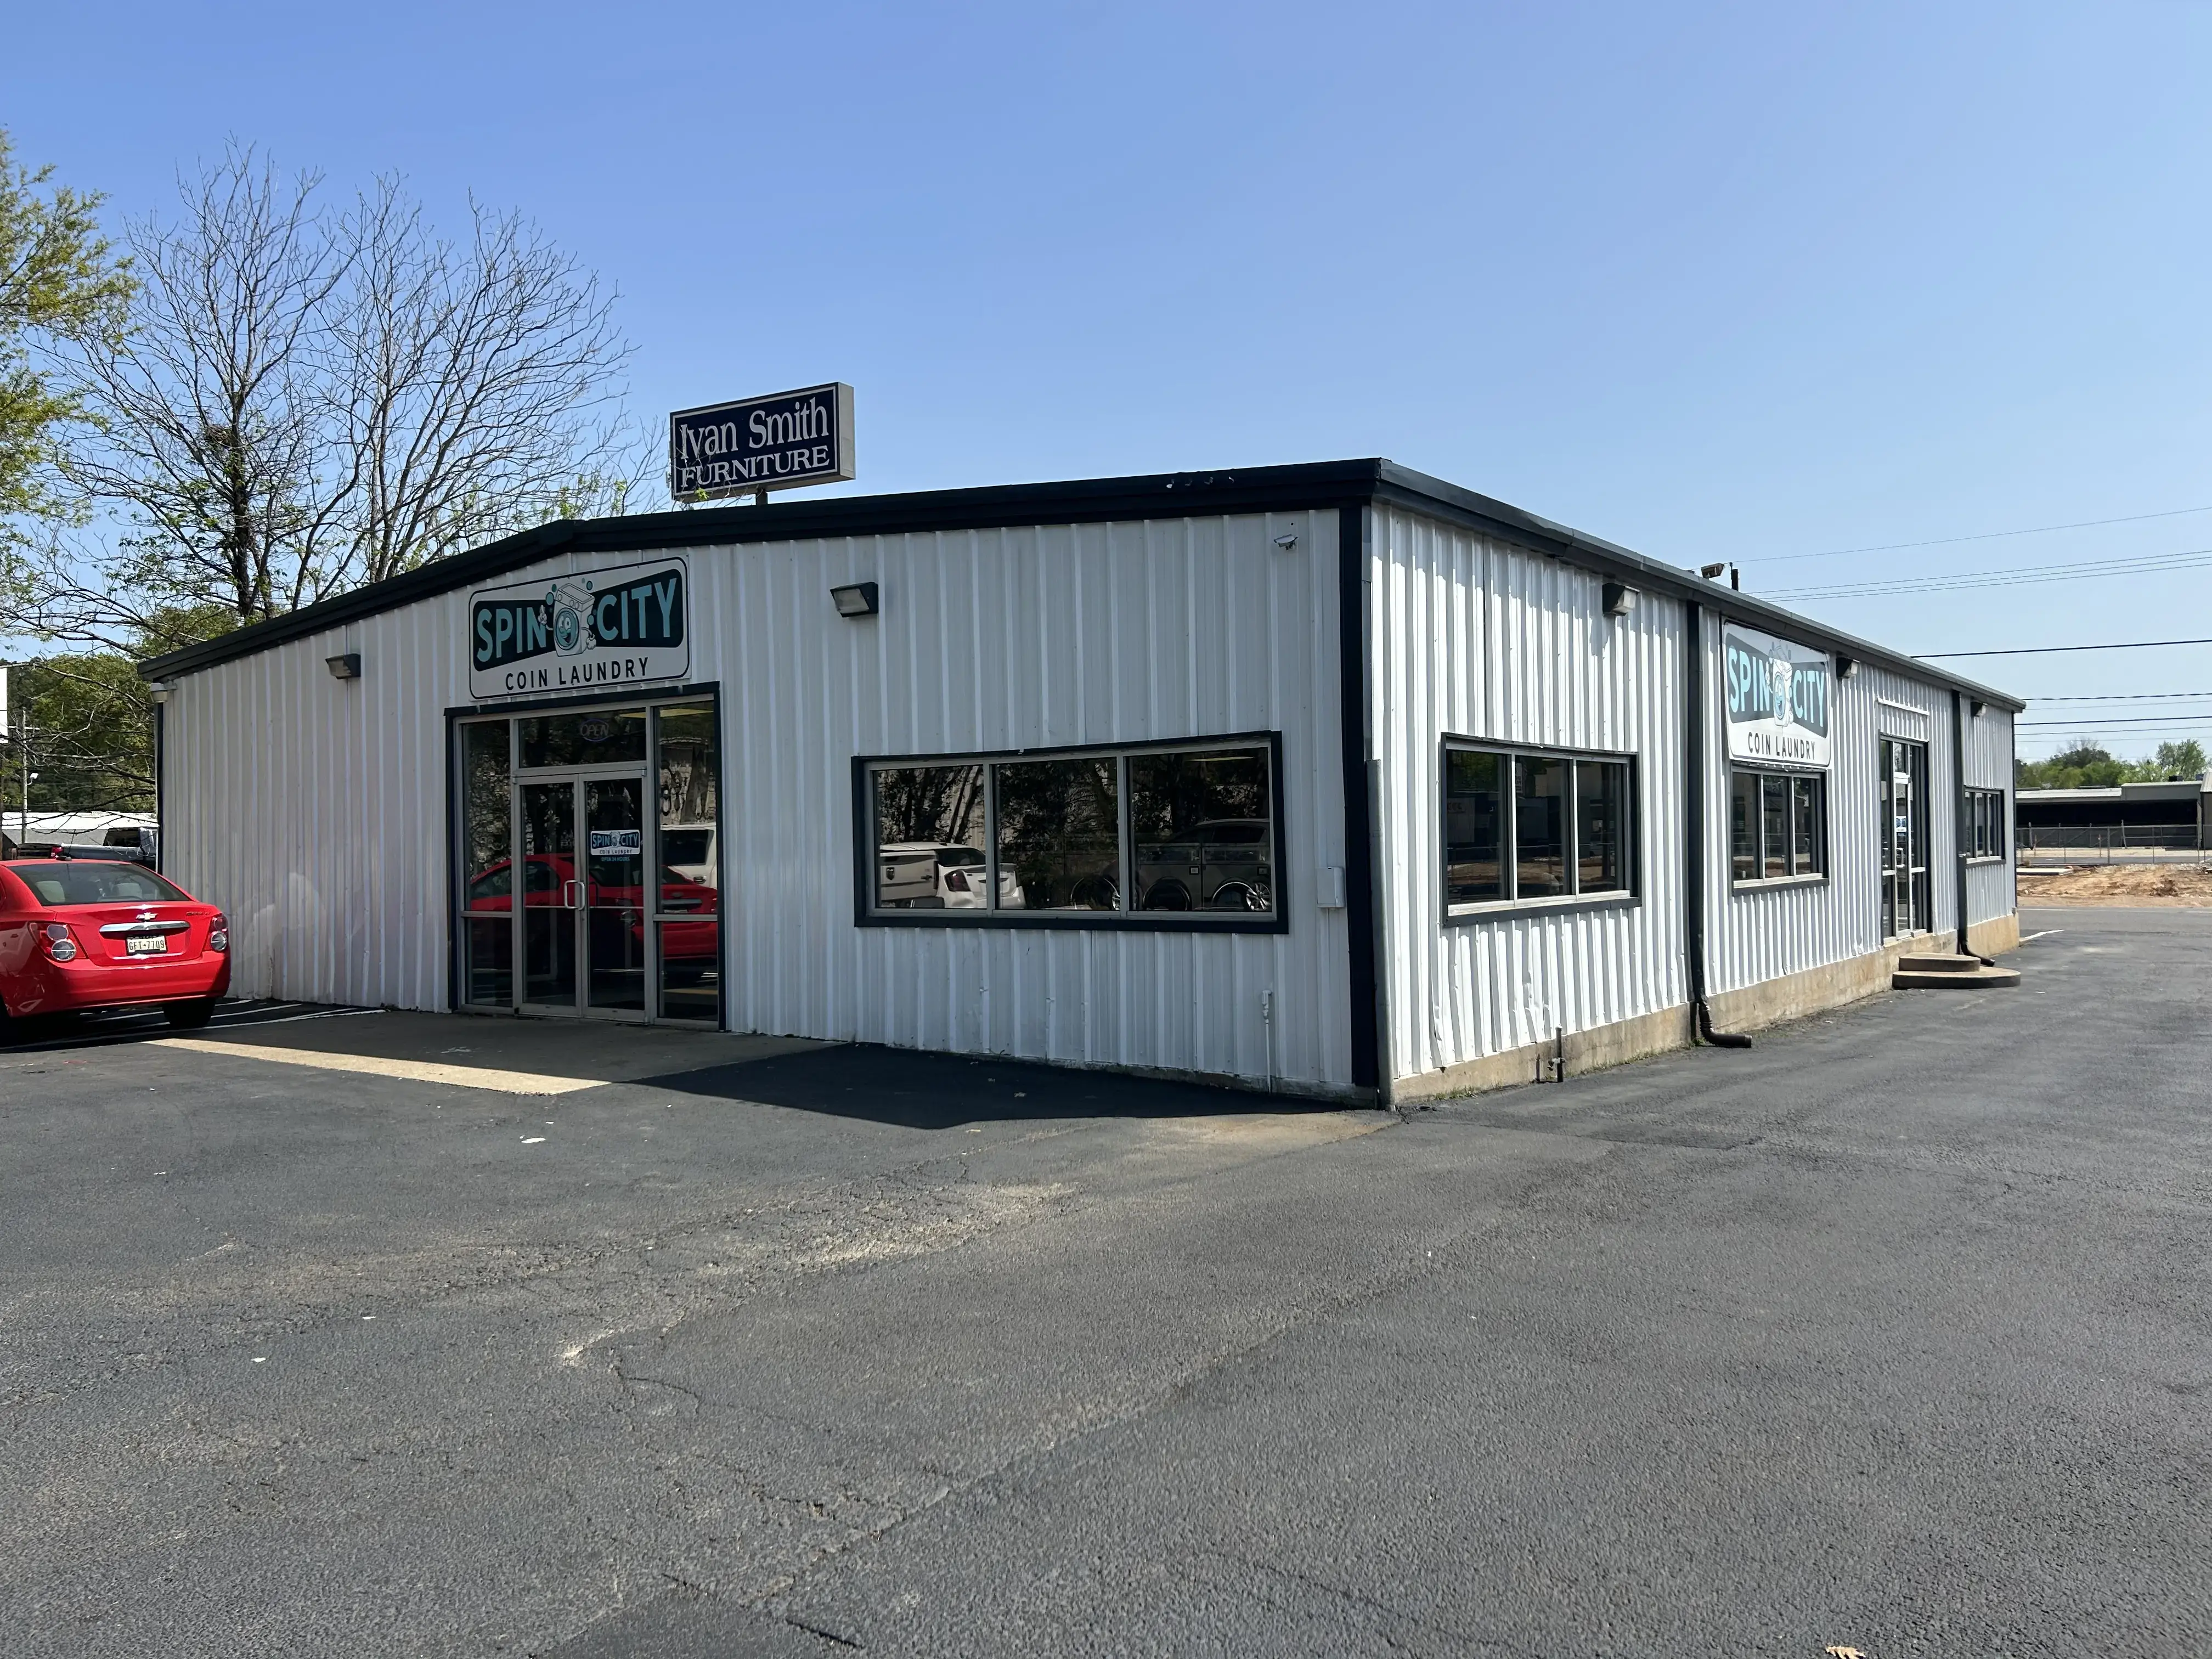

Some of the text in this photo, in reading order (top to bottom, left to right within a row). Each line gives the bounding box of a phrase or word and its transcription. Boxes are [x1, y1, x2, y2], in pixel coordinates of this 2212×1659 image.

[680, 398, 829, 460] Ivan Smith
[681, 445, 830, 487] FURNITURE
[477, 578, 677, 662] SPIN CITY
[505, 657, 648, 690] COIN LAUNDRY
[1728, 646, 1825, 727] SPIN CITY
[582, 725, 609, 736] OPEN
[1748, 732, 1815, 760] COIN LAUNDRY
[592, 833, 638, 847] SPIN CITY
